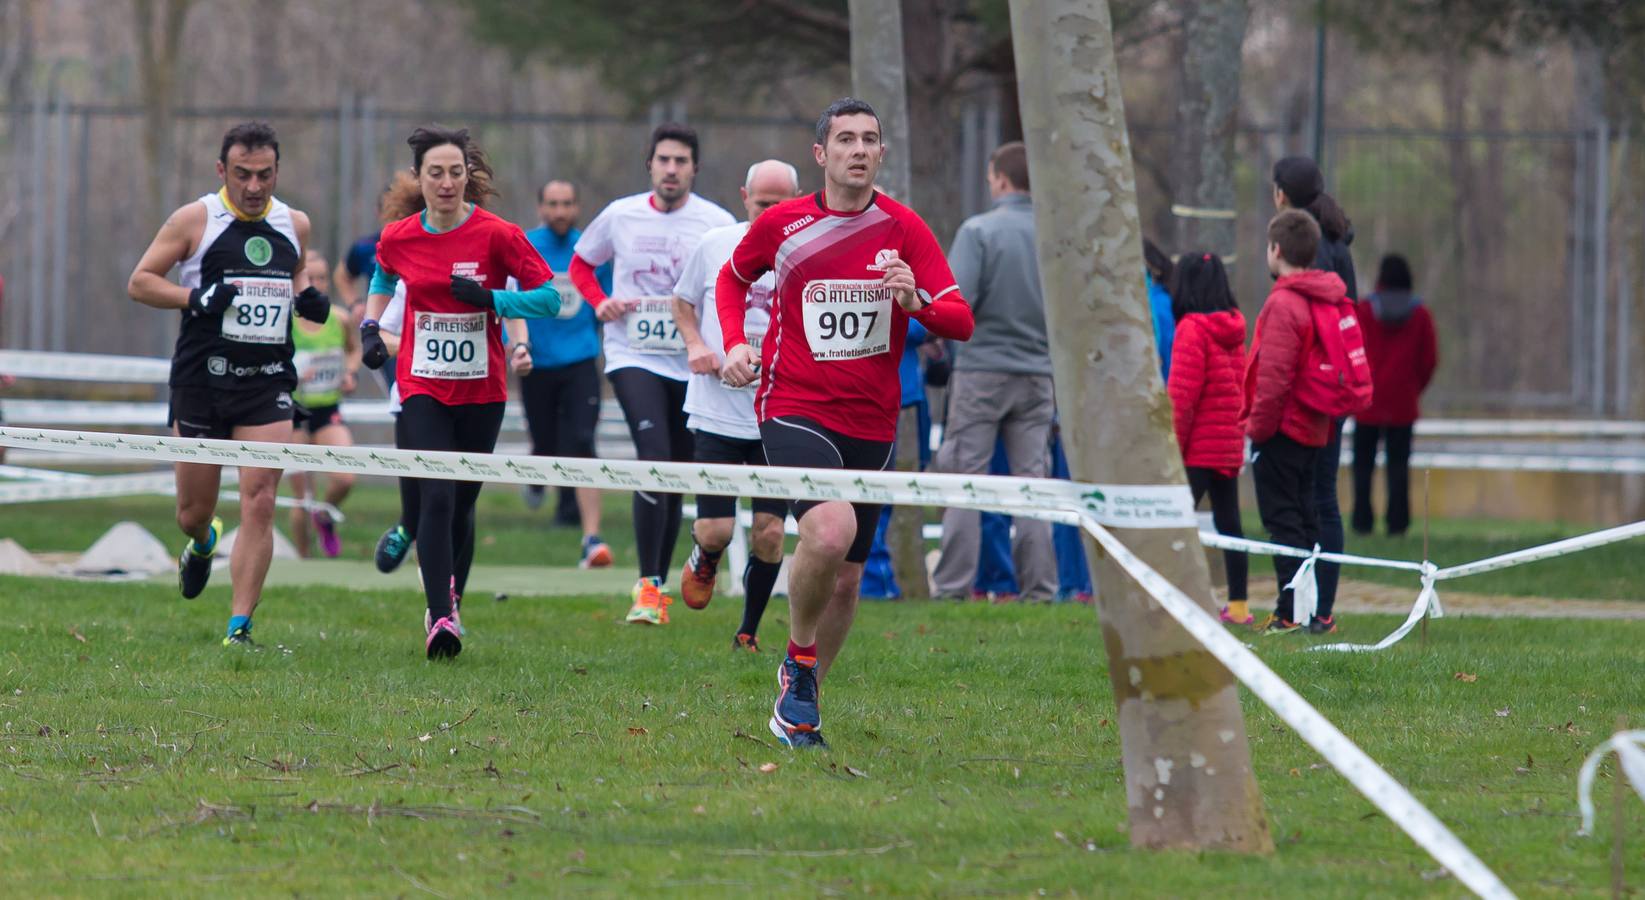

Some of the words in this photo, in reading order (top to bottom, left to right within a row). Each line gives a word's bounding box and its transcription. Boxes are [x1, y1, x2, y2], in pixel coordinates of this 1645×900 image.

[246, 285, 291, 299] ATLETISMO
[829, 287, 891, 303] ATLETISMO
[236, 303, 282, 328] 897
[818, 310, 879, 341] 907
[433, 321, 485, 333] ATLETISMO
[637, 319, 681, 340] 947
[426, 338, 475, 362] 900
